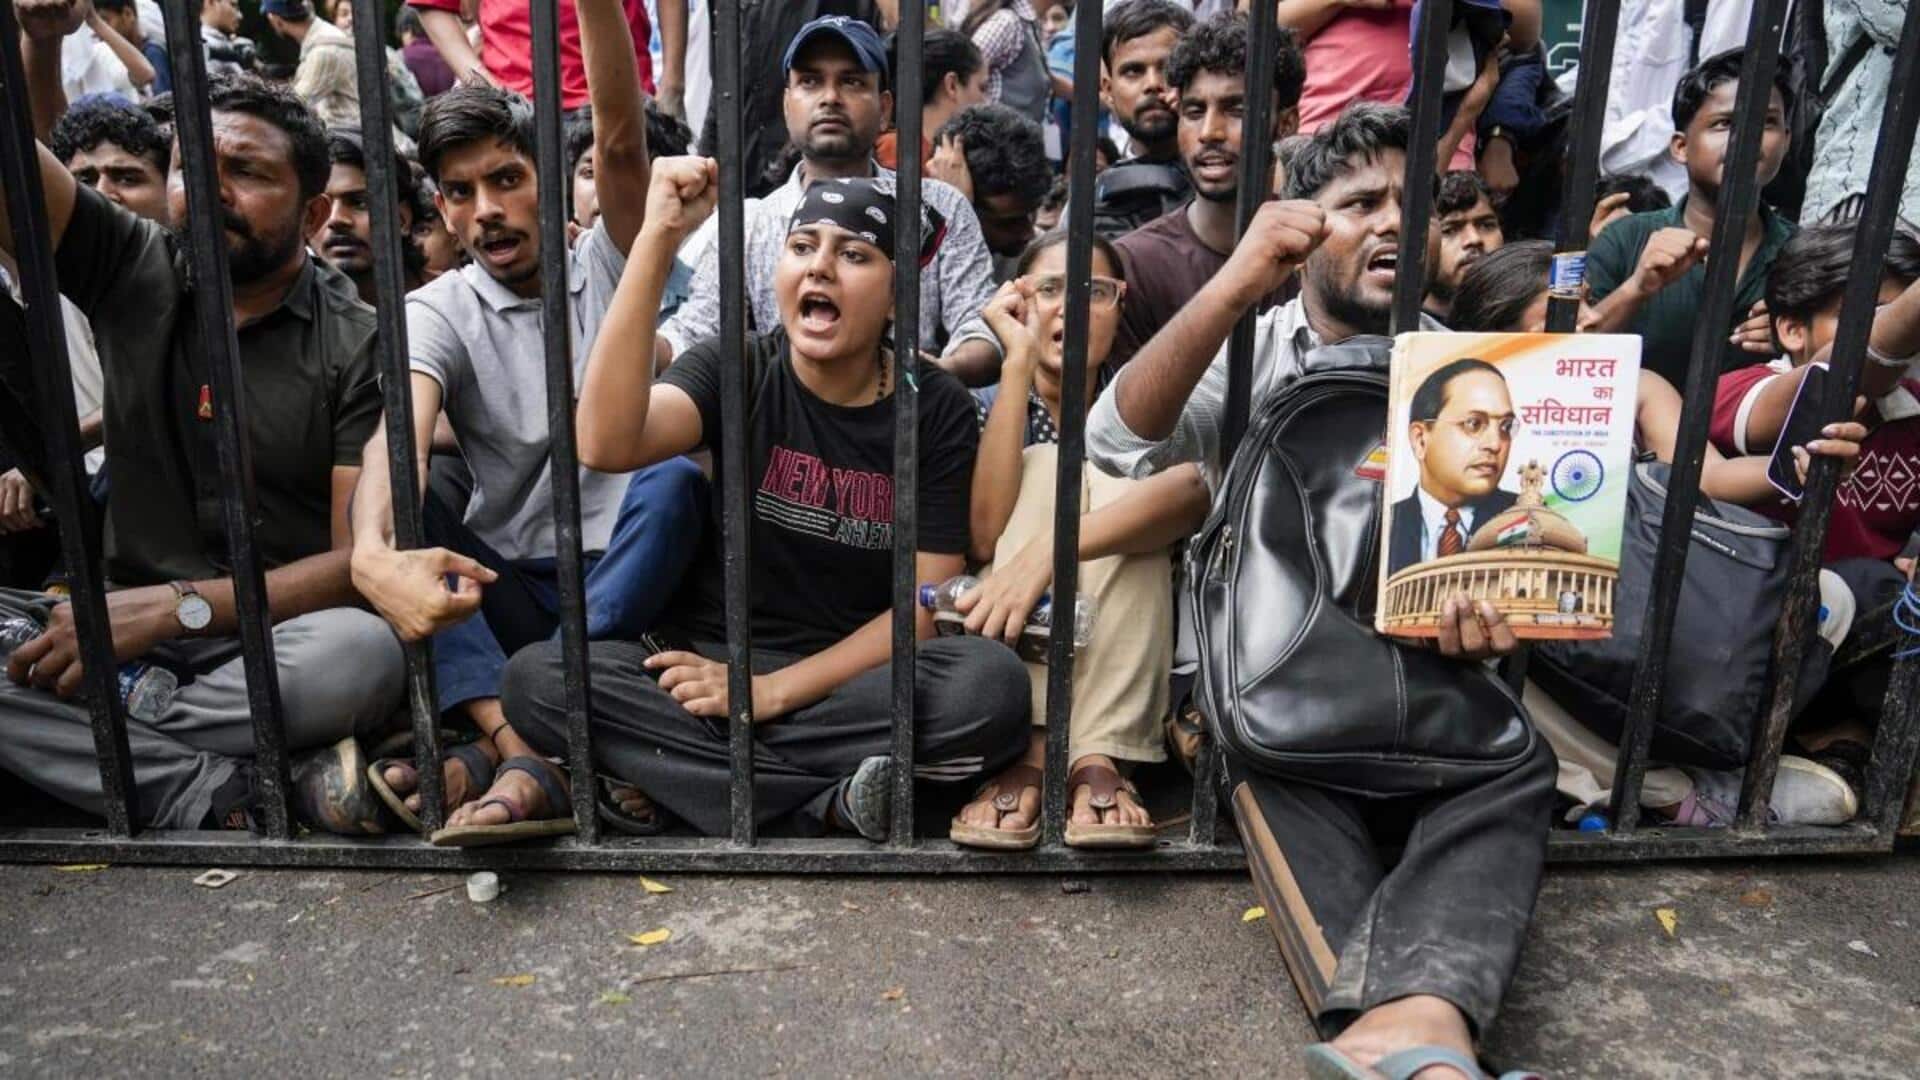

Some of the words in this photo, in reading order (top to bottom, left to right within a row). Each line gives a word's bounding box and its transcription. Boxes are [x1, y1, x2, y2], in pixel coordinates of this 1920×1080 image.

[1555, 358, 1617, 378] भारत
[1592, 386, 1614, 401] का
[1519, 397, 1613, 425] संविधान
[761, 445, 830, 507] NEW
[832, 467, 896, 524] YOR
